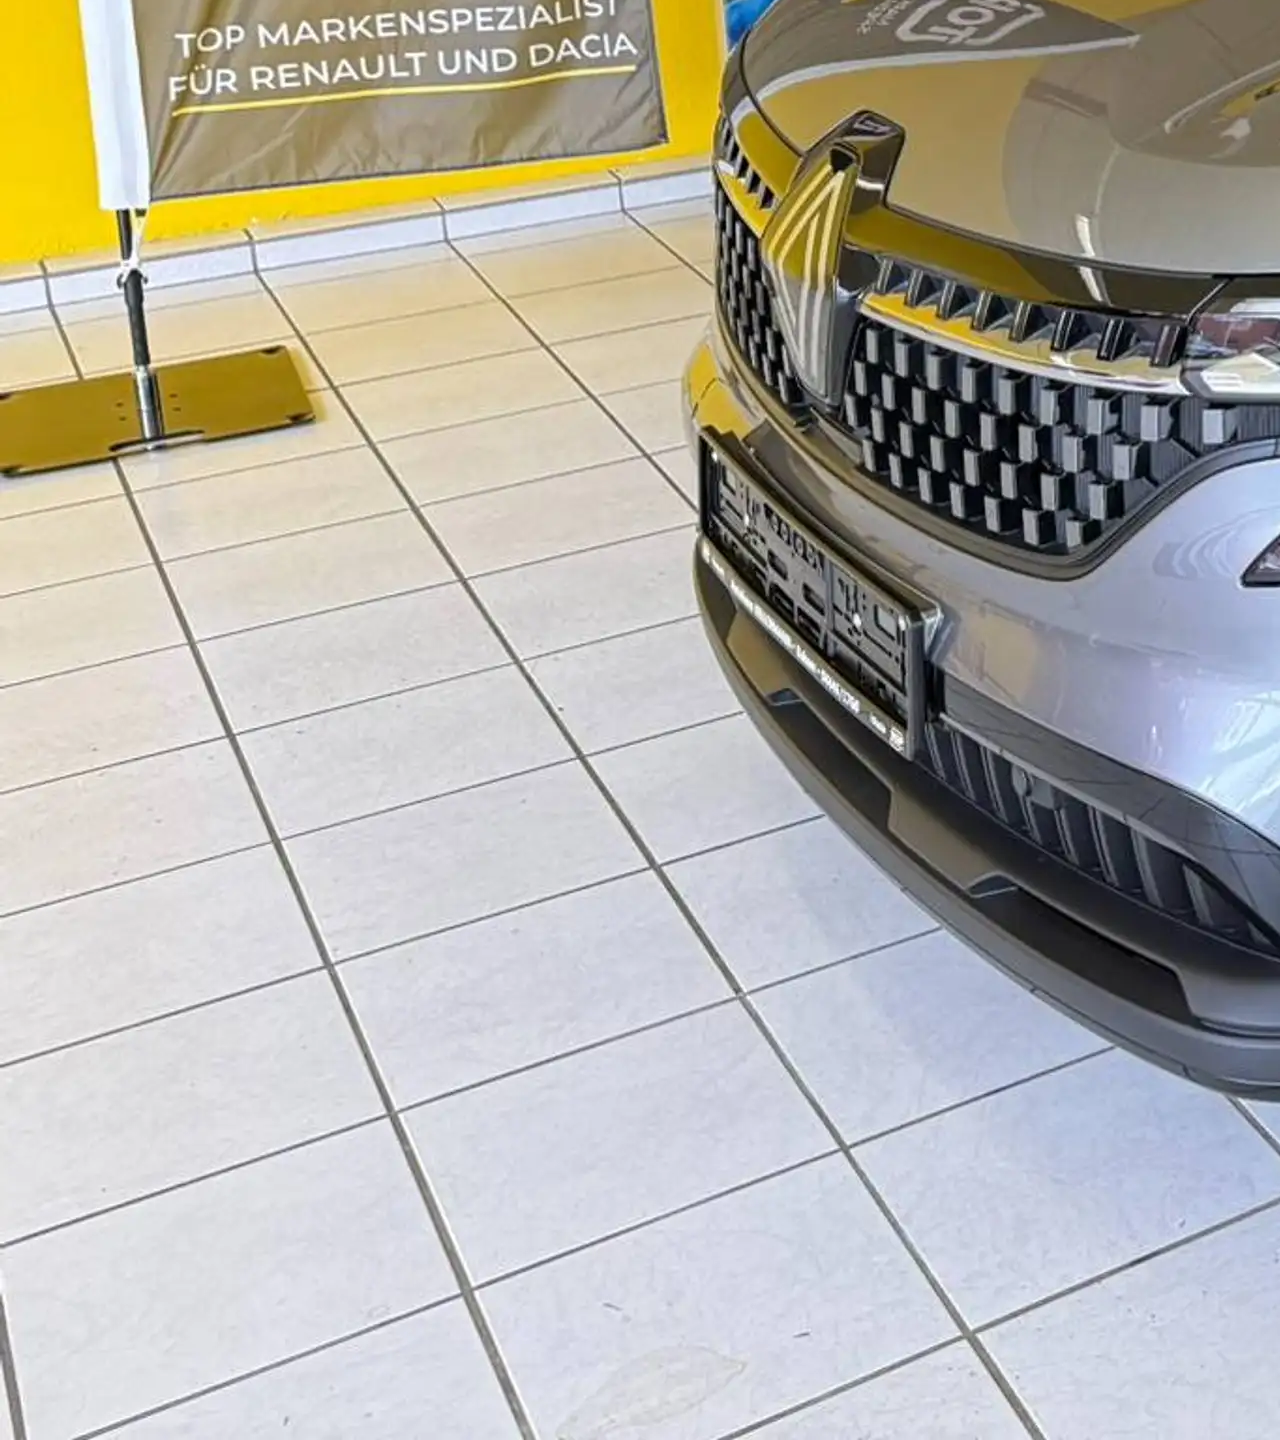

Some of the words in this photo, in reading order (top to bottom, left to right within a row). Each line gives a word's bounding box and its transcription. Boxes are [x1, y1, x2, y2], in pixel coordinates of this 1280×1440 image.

[167, 64, 239, 101] FÜR
[249, 51, 427, 92] RENAULT
[437, 47, 518, 77] UND
[528, 32, 638, 68] DACIA
[174, 24, 246, 59] TOP
